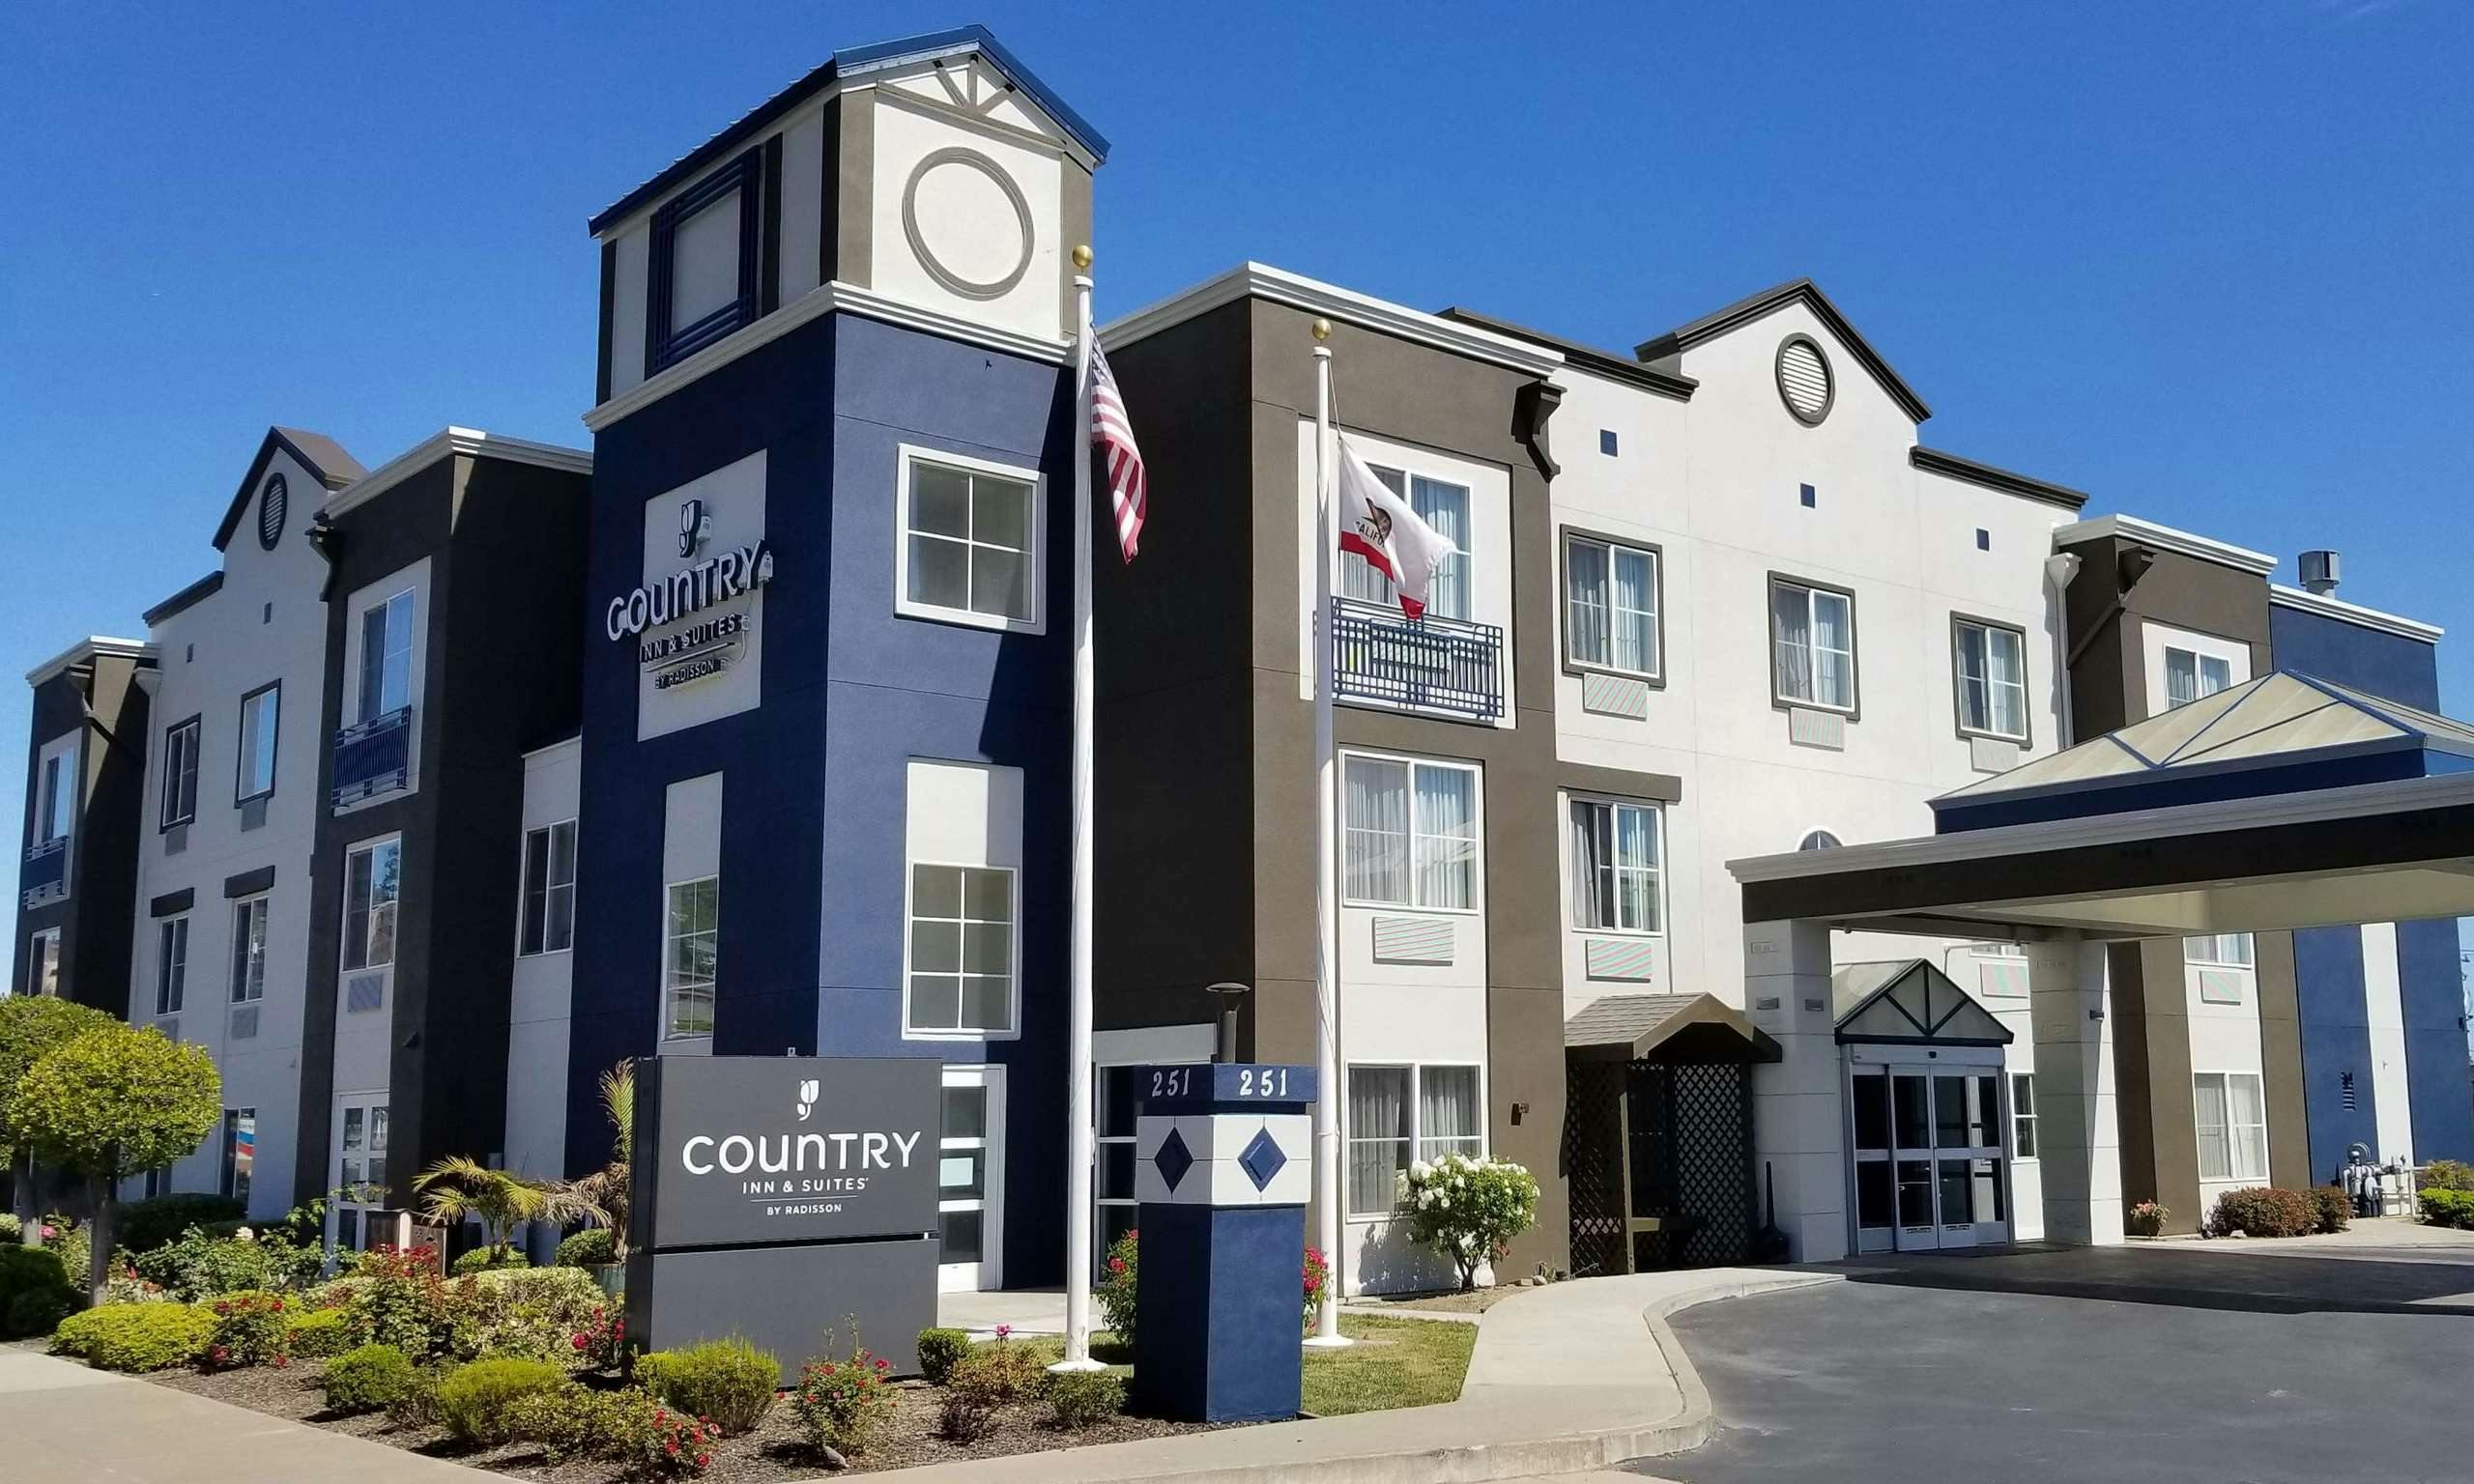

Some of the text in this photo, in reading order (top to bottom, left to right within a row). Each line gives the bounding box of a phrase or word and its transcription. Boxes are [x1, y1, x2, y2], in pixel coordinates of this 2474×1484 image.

[607, 539, 765, 642] COUNTRY
[669, 634, 679, 653] &
[682, 614, 737, 647] SUITES
[654, 659, 716, 689] BY RADISSON
[1151, 1068, 1191, 1098] 251
[1239, 1068, 1287, 1098] 251
[682, 1130, 921, 1175] COUNTRY
[742, 1177, 866, 1194] INN & SUITES
[766, 1203, 842, 1216] BY RADISSON
